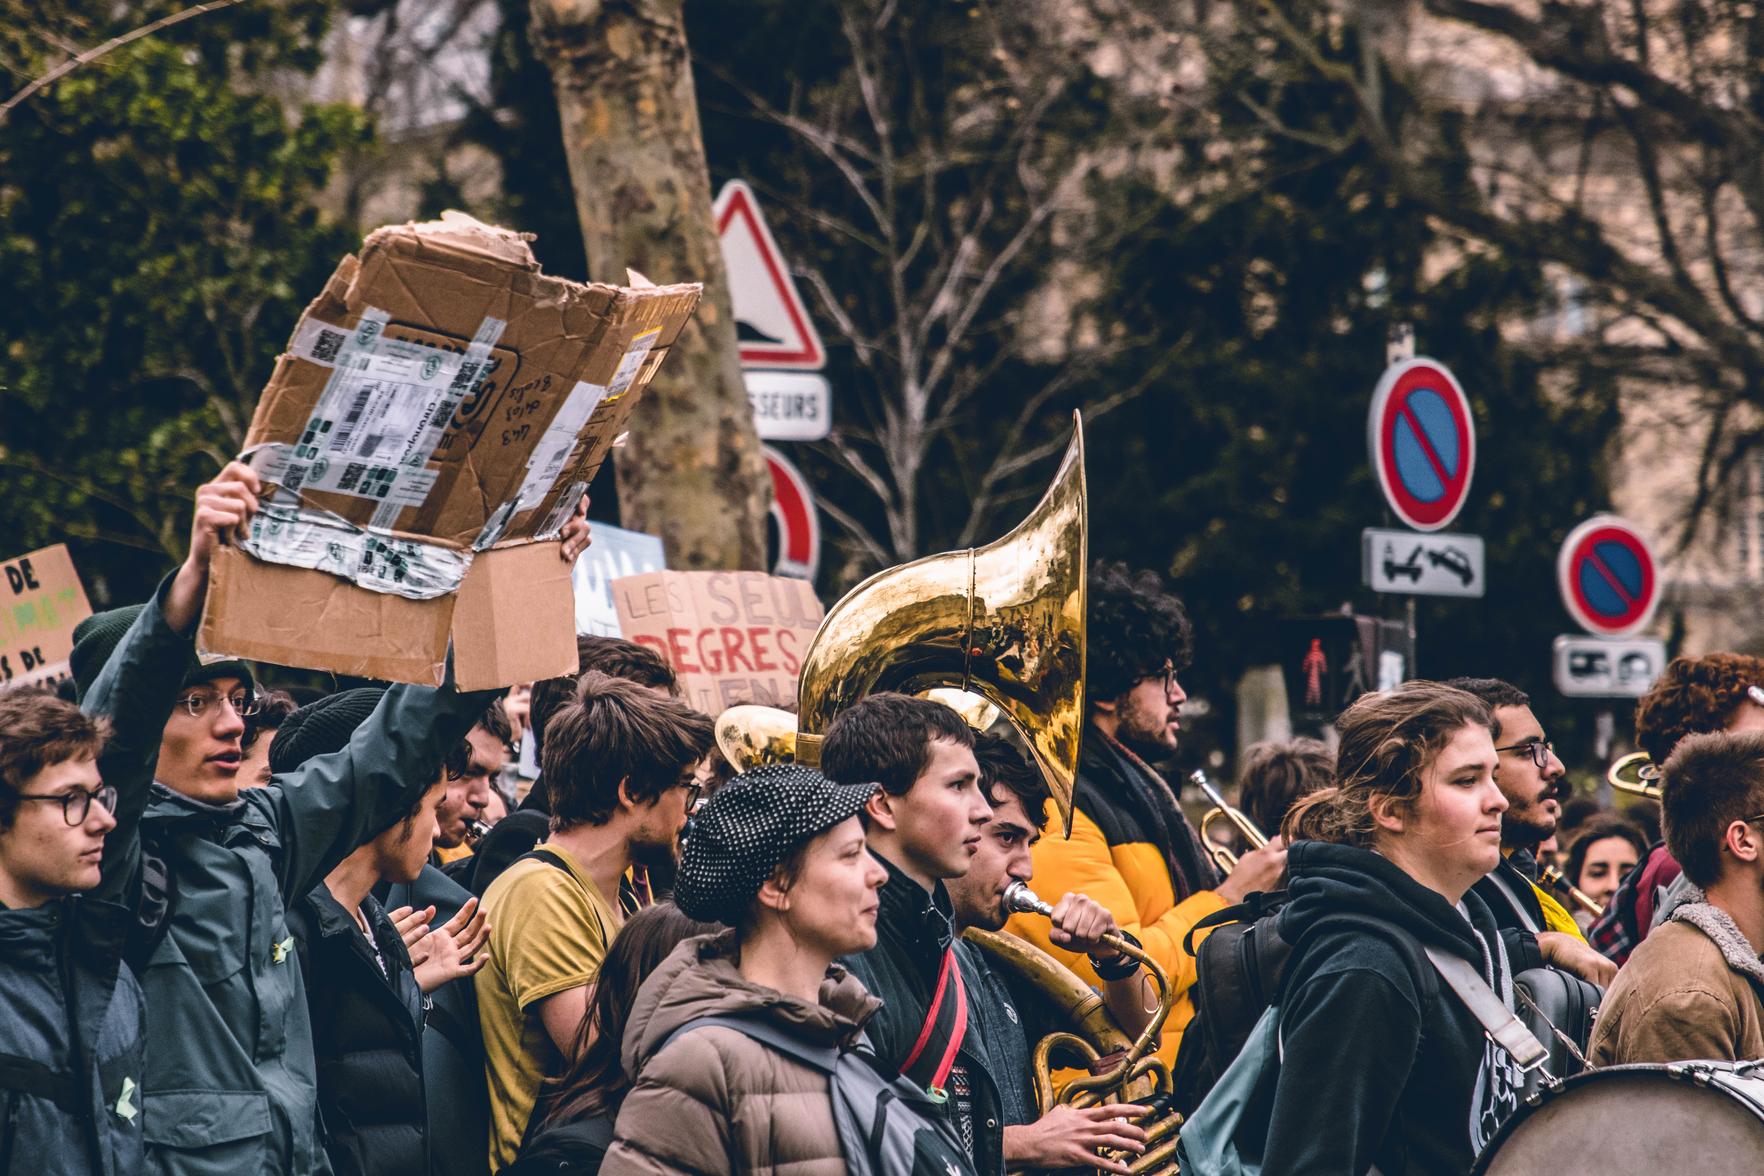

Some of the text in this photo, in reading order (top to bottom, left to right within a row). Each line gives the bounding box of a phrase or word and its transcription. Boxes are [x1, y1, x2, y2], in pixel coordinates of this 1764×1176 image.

[749, 392, 817, 421] SEURS
[4, 558, 40, 595] DE
[624, 583, 684, 619] LES
[0, 647, 45, 680] S DE
[633, 626, 801, 676] DEGRES
